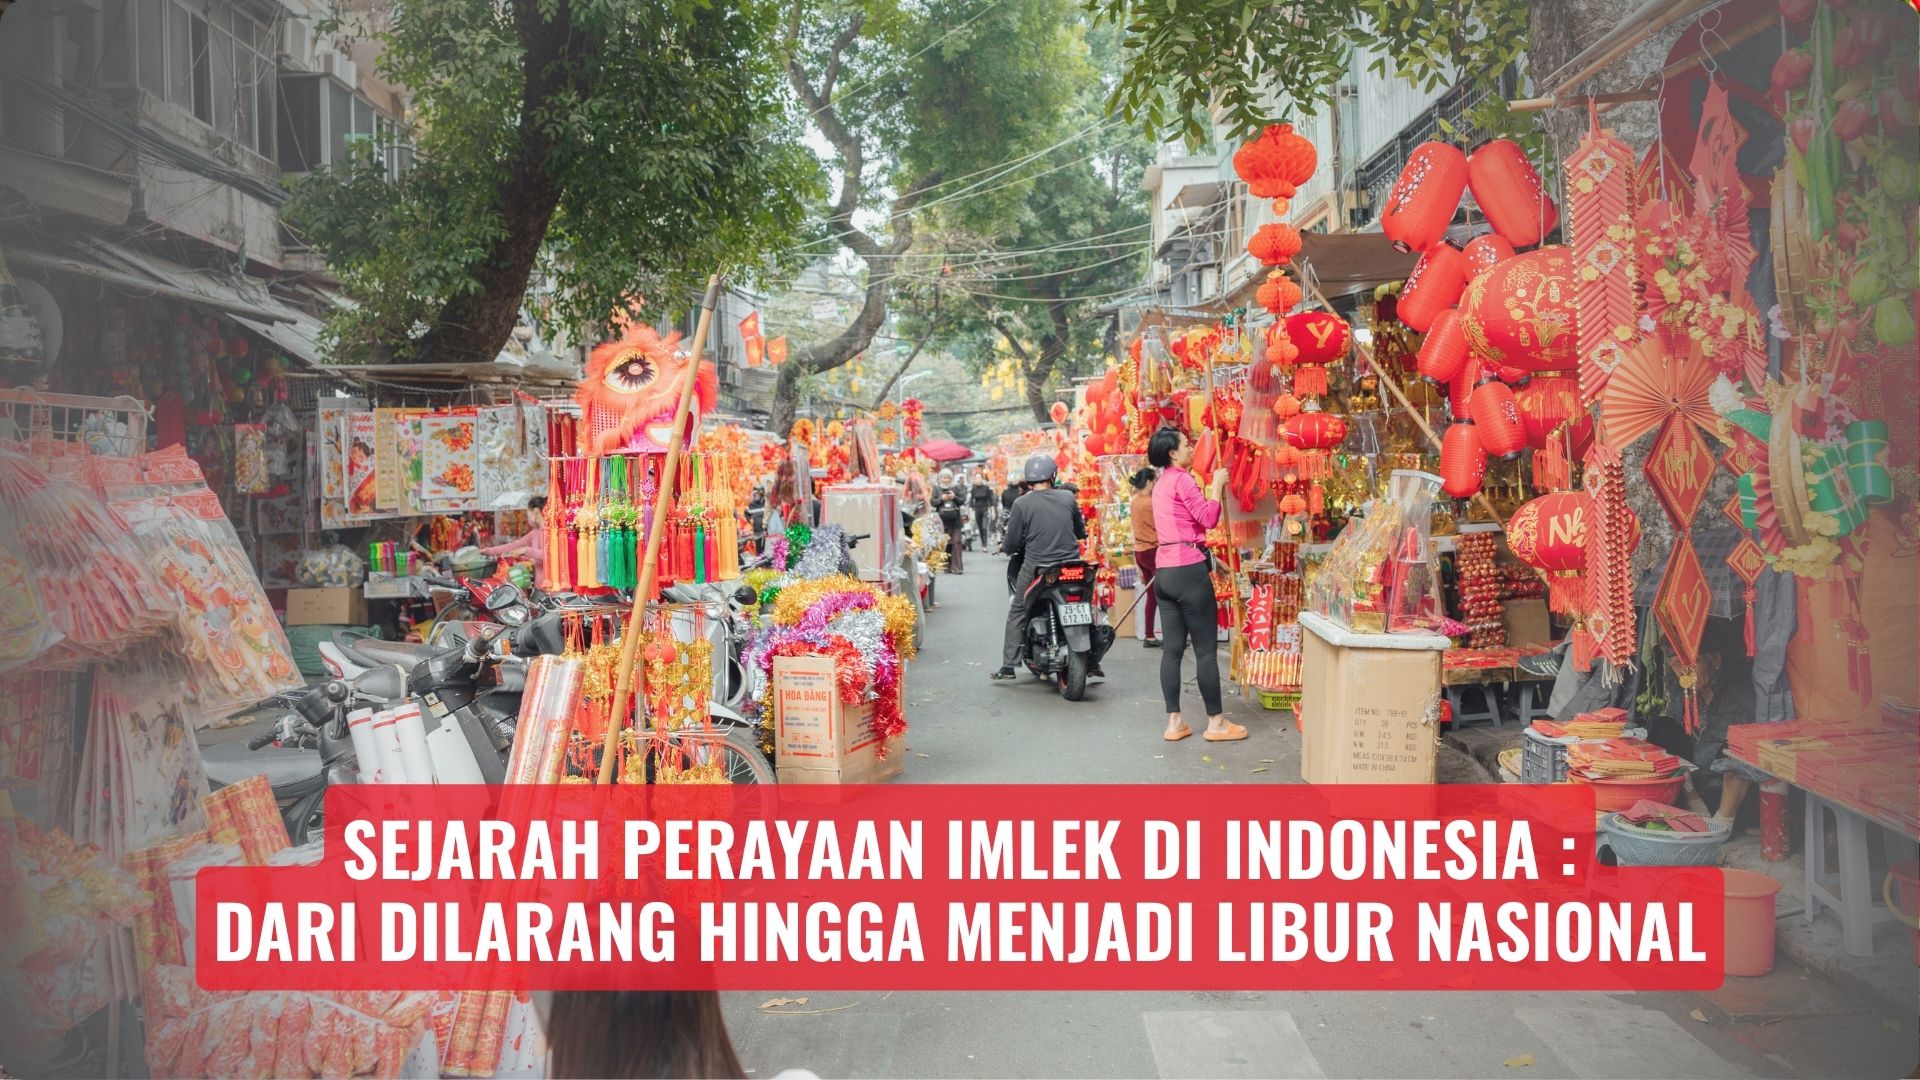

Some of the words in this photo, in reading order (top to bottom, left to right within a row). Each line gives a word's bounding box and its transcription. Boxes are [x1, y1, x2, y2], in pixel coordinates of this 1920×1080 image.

[785, 690, 802, 701] HOA
[1355, 707, 1370, 716] ITEM
[1353, 763, 1369, 771] MADE
[1379, 764, 1397, 772] CHINA
